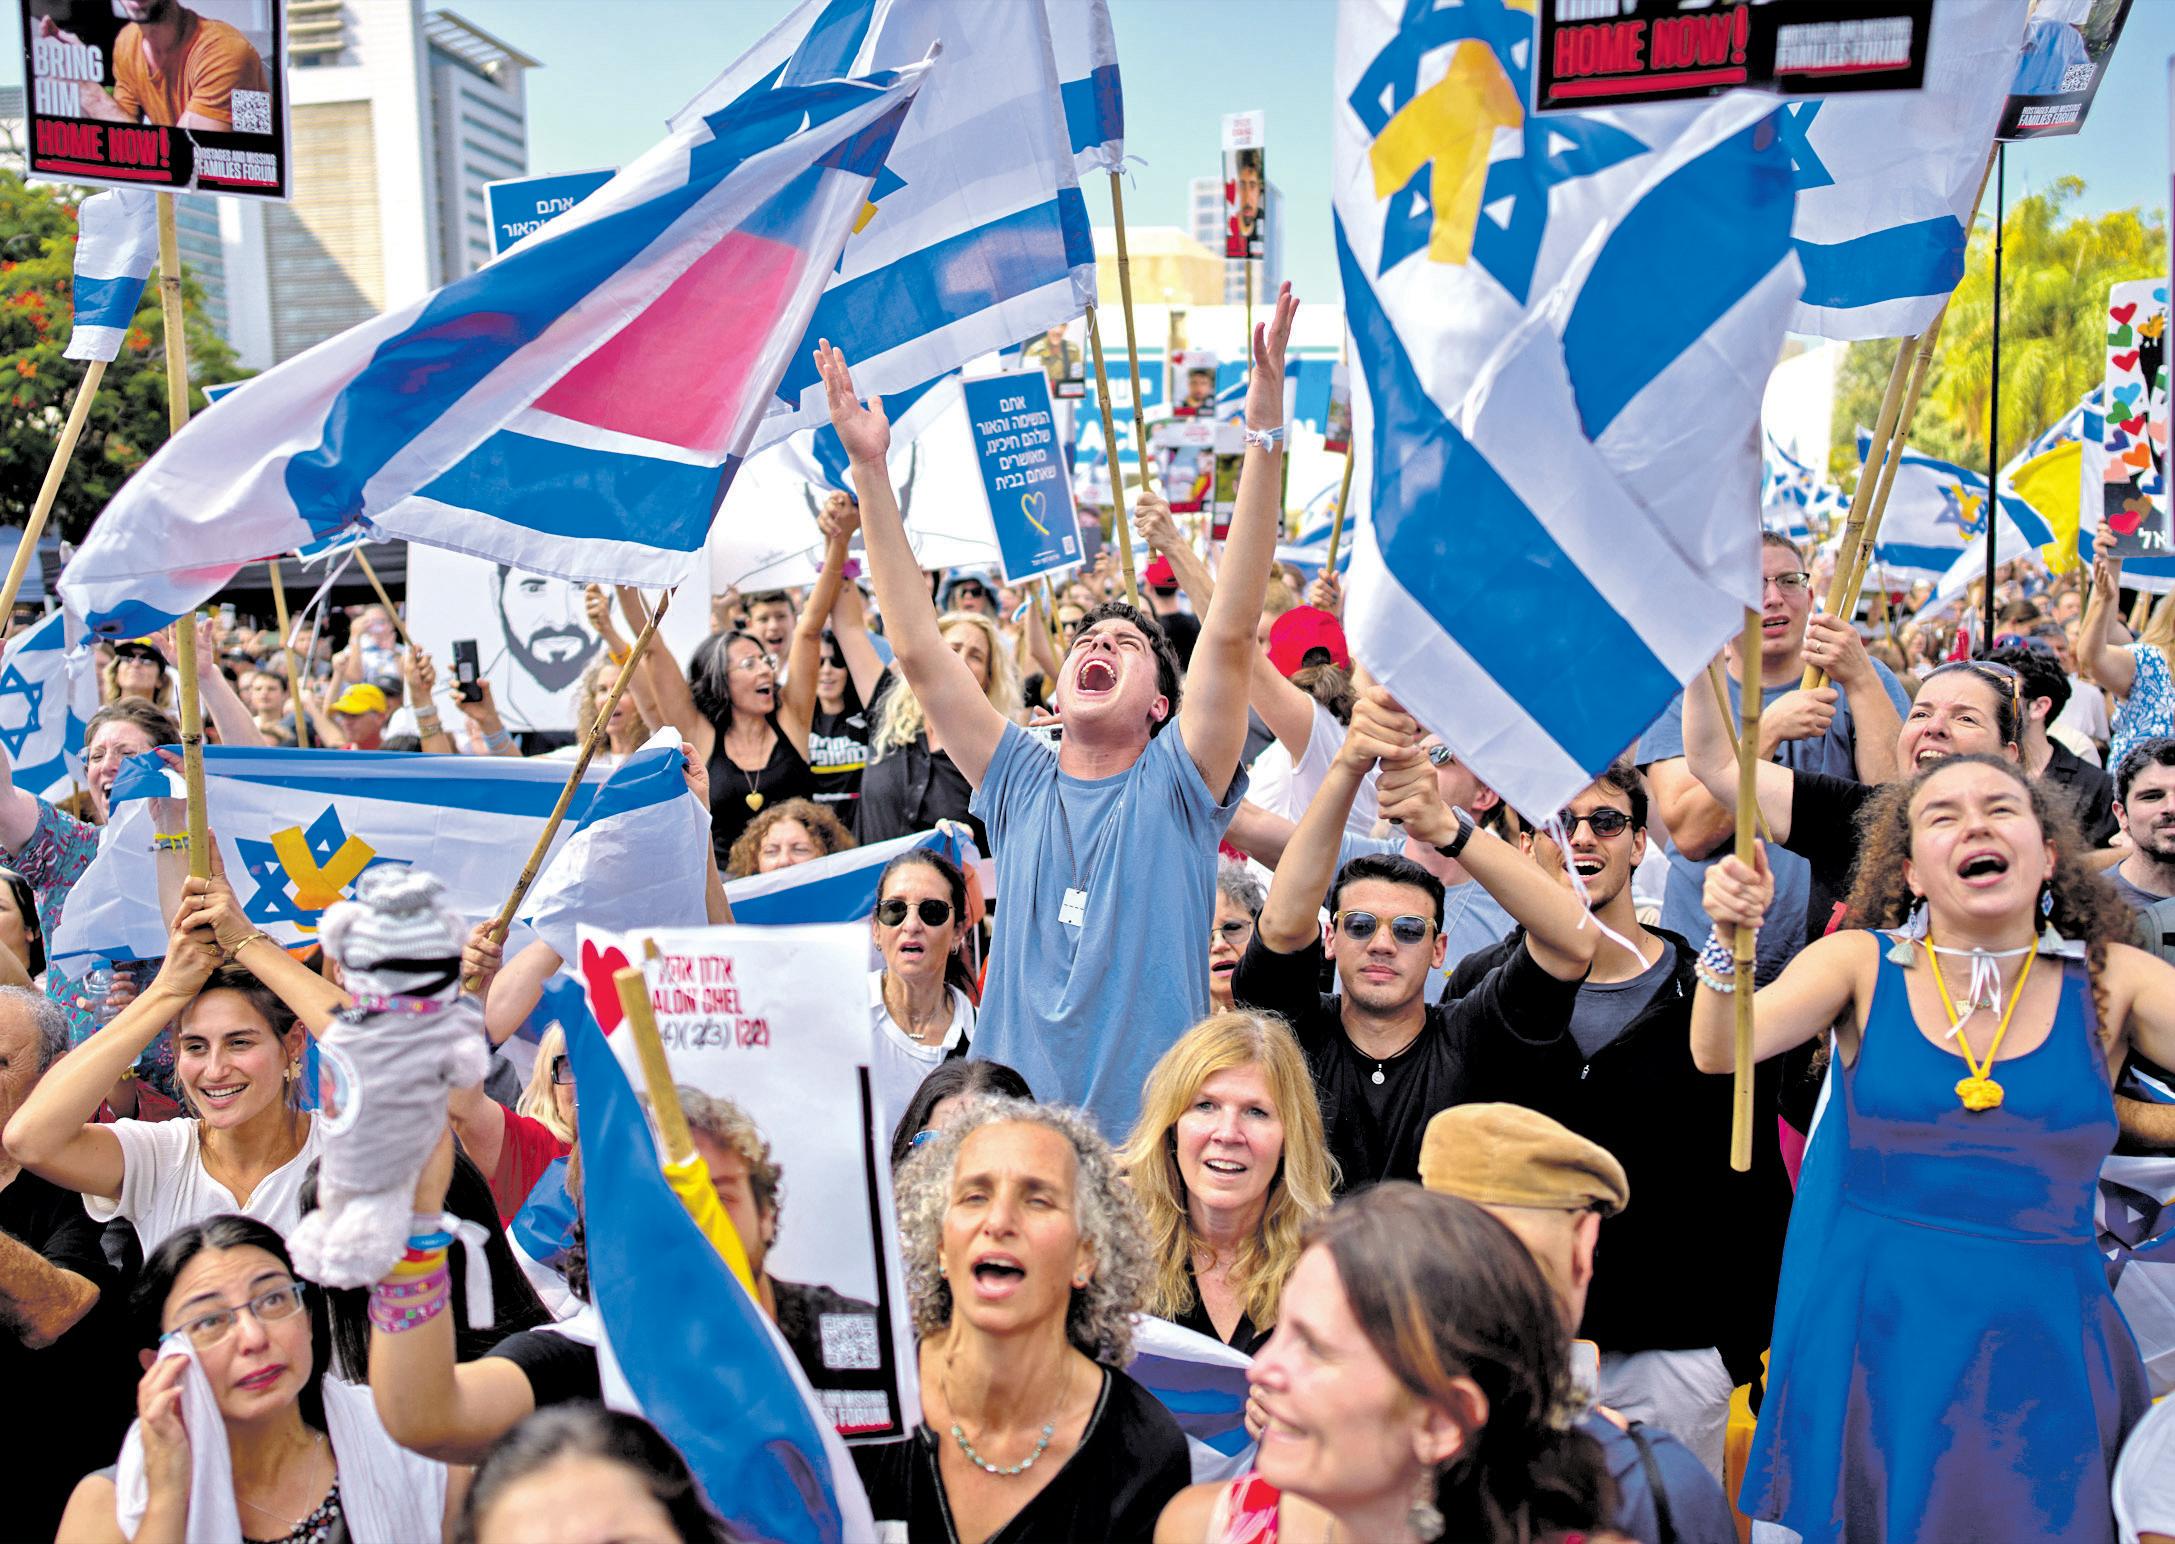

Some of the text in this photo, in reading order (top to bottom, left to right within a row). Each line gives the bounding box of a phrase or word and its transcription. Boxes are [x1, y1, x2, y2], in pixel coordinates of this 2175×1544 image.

[1554, 5, 1748, 77] HOME NOW!
[33, 43, 104, 83] BRING
[35, 77, 80, 118] HIM
[2018, 111, 2078, 126] FAMILIES FORUM
[36, 119, 170, 168] HOME NOW!
[199, 159, 277, 182] FAMILIES FORUM
[536, 197, 575, 214] אתם
[1000, 396, 1027, 412] אתם
[976, 418, 1010, 435] והאור
[1021, 428, 1051, 447] שלהם
[995, 465, 1056, 491] שאתם בבית
[653, 989, 696, 1015] ALON
